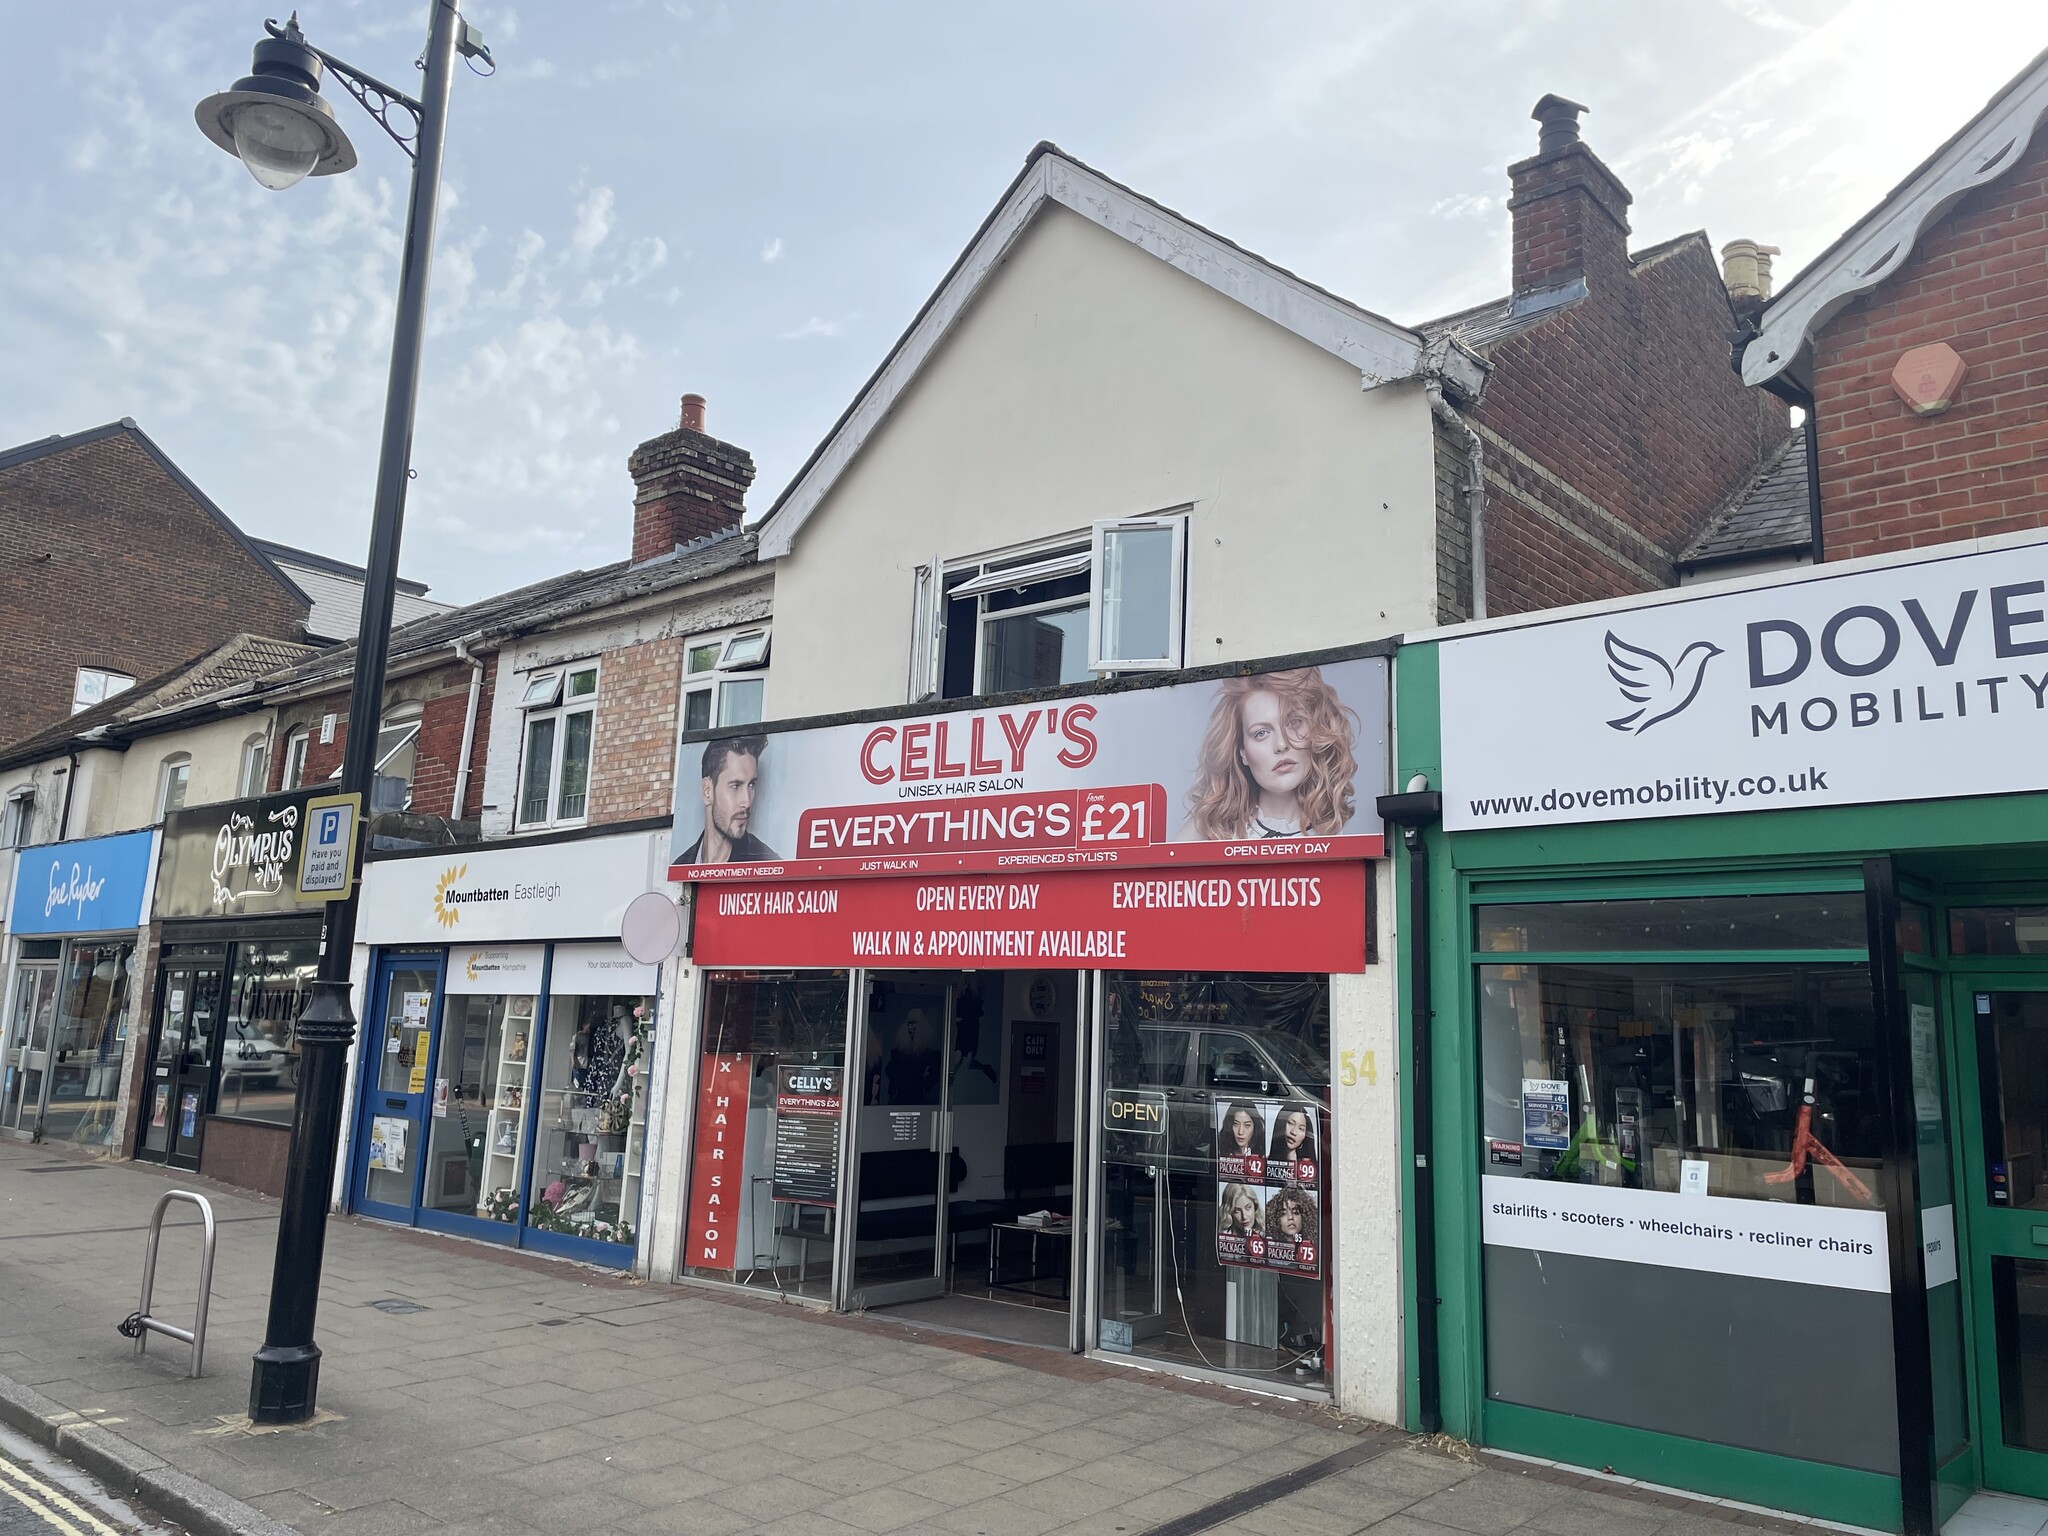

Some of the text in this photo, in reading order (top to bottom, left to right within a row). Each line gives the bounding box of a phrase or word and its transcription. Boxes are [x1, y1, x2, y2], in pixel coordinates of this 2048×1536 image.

[1746, 579, 2048, 689] DOVE
[1751, 672, 2048, 738] MOBILITY
[859, 703, 1098, 786] CELLY'S
[898, 778, 1024, 798] UNISEX HAIR SALON
[1085, 792, 1105, 803] From
[1470, 766, 1829, 816] www.dovemobility.co.uk
[323, 815, 336, 842] P
[809, 800, 1145, 849] EVERYTHING'S £21
[213, 824, 293, 878] OLYMPUS
[311, 850, 342, 860] Have you
[688, 842, 1331, 879] NO APPOINTMENT NEEDED JUST WALK IN EXPERIENCED STYLISTS OPEN EVERY DAY
[310, 861, 339, 872] paid and
[45, 860, 105, 921] Sue Ryder
[445, 882, 561, 904] Mountbatten Eastleigh
[916, 884, 1040, 912] OPEN EVERY DAY
[1113, 877, 1322, 909] EXPERIENCED STYLISTS
[718, 889, 838, 916] UNISEX HAIR SALON
[852, 930, 1127, 958] WALK IN & APPOINTMENT AVAILABLE
[484, 951, 509, 961] Supporting
[587, 960, 633, 970] Your local hospice
[471, 963, 526, 972] Mountbatten Hampshire
[1340, 1050, 1377, 1086] 54
[789, 1075, 832, 1090] CELLY'S
[1541, 1082, 1560, 1090] DOVE
[779, 1097, 840, 1108] EVERYTHING'S £24
[1111, 1101, 1159, 1122] OPEN
[712, 1096, 730, 1160] HAIR
[1492, 1142, 1521, 1152] WARNING
[1219, 1162, 1245, 1175] PACKAGE
[1266, 1166, 1295, 1179] PACKAGE
[703, 1175, 721, 1260] SALON
[1492, 1203, 1874, 1256] stairlifts scooters wheelchairs recliner chairs
[1219, 1241, 1246, 1255] PACKAGE
[1267, 1247, 1296, 1261] PACKAGE
[1926, 1238, 1942, 1257] repairs
